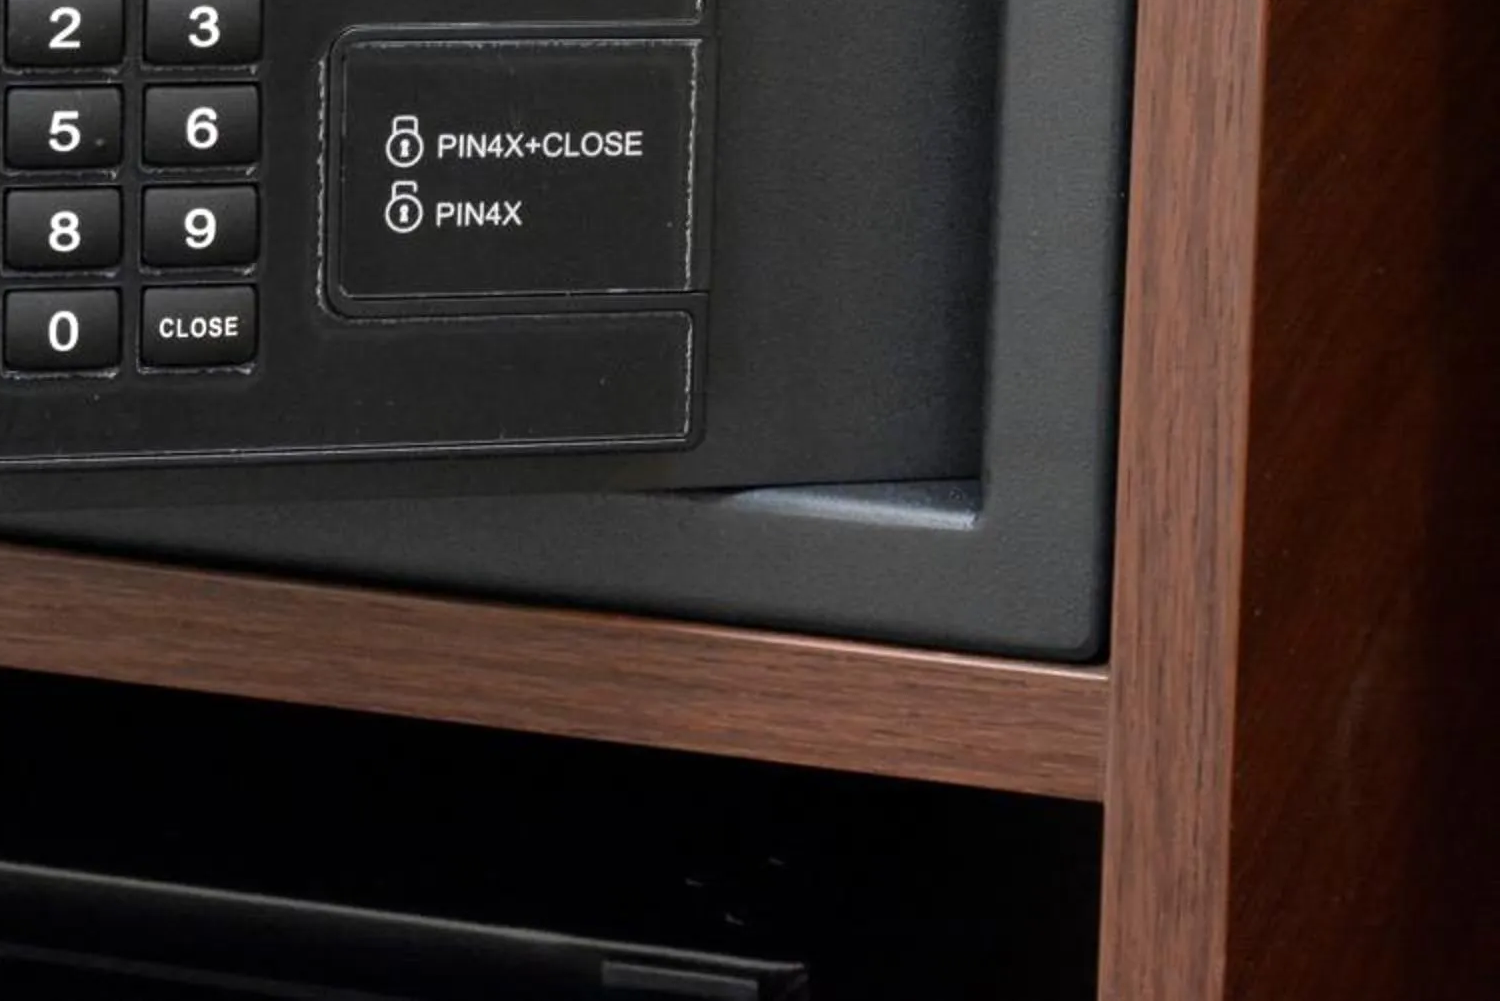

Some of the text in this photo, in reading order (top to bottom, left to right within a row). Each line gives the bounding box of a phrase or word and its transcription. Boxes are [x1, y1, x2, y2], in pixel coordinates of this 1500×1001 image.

[48, 6, 82, 49] 2
[187, 4, 221, 48] 3
[48, 110, 81, 152] 5
[185, 106, 219, 149] 6
[437, 130, 644, 159] PIN4X+CLOSE
[48, 210, 81, 253] 8
[183, 207, 217, 249] 9
[435, 200, 523, 228] PIN4X
[48, 310, 79, 352] 0
[158, 314, 239, 339] CLOSE
